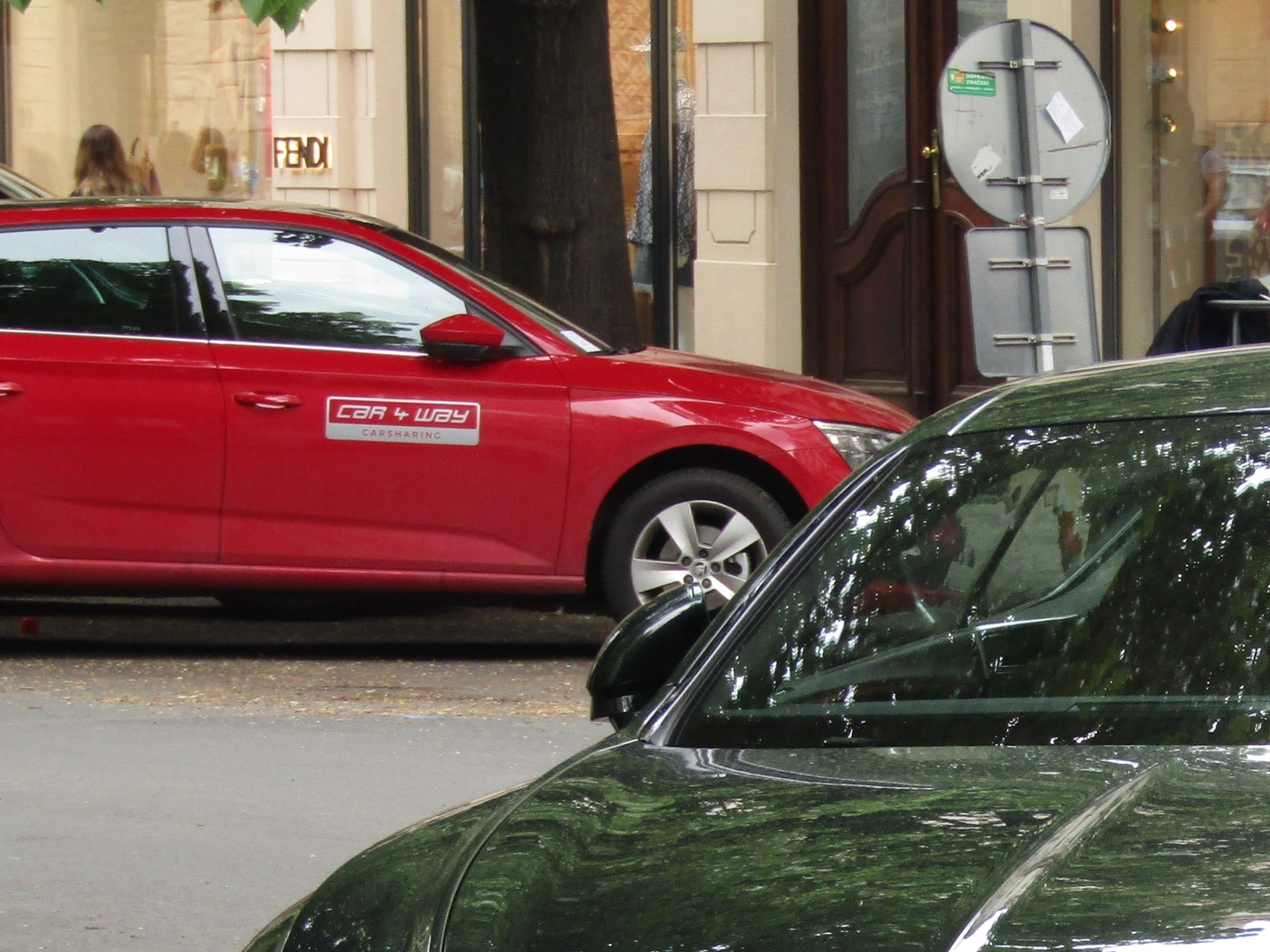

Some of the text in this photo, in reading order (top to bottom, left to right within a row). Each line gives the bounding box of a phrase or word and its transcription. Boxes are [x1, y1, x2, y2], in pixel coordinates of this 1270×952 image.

[273, 136, 329, 168] FENDI
[393, 407, 410, 421] 4
[362, 428, 441, 440] CARSHARING
